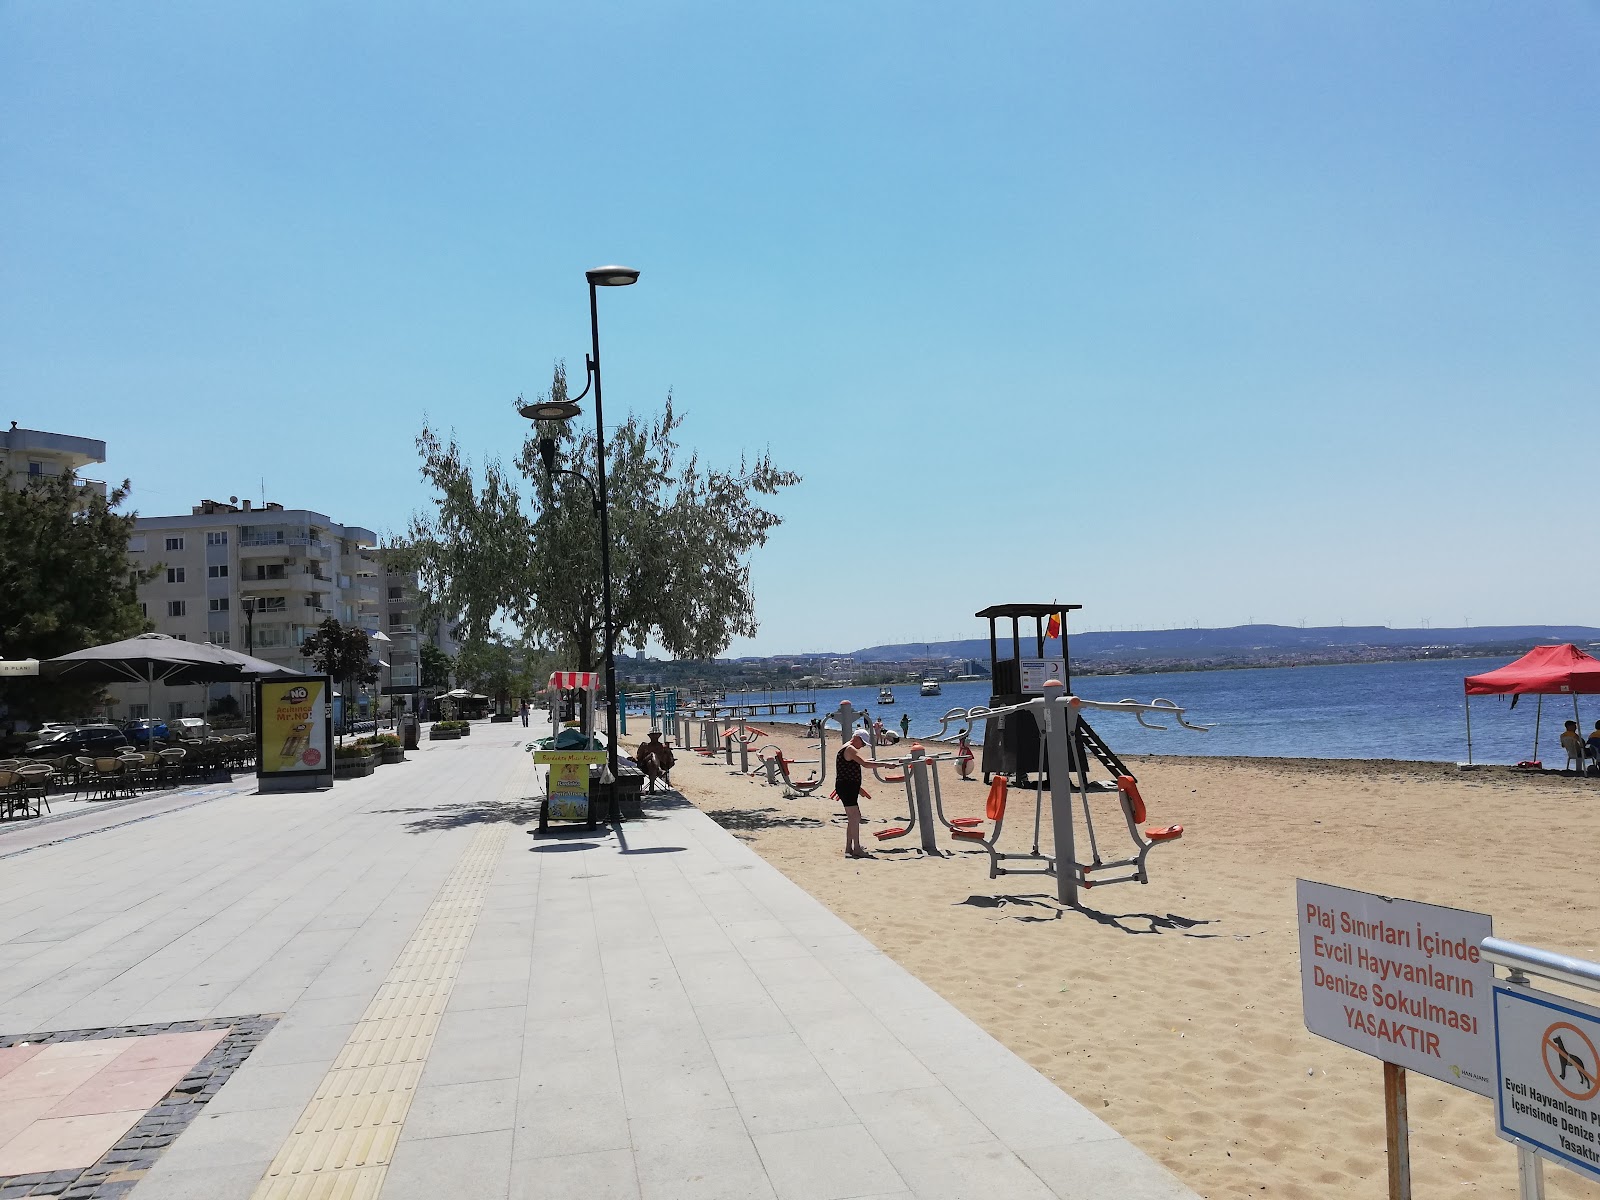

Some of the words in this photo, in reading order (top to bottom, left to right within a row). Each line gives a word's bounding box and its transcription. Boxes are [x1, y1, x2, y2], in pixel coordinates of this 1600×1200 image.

[1307, 903, 1335, 935] Plaj
[1341, 911, 1410, 948] Sınırları
[1416, 922, 1480, 964] İçinde
[1313, 935, 1353, 965] Evcil
[1357, 946, 1474, 998] Hayvanların
[1313, 964, 1368, 1002] Denize
[1372, 983, 1478, 1035] Sokulması
[1343, 1005, 1441, 1059] YASAKTIR
[1505, 1077, 1527, 1097] Evcil
[1529, 1086, 1588, 1122] Hayvanların
[1511, 1094, 1558, 1128] İçerisinde
[1561, 1117, 1595, 1143] Denize
